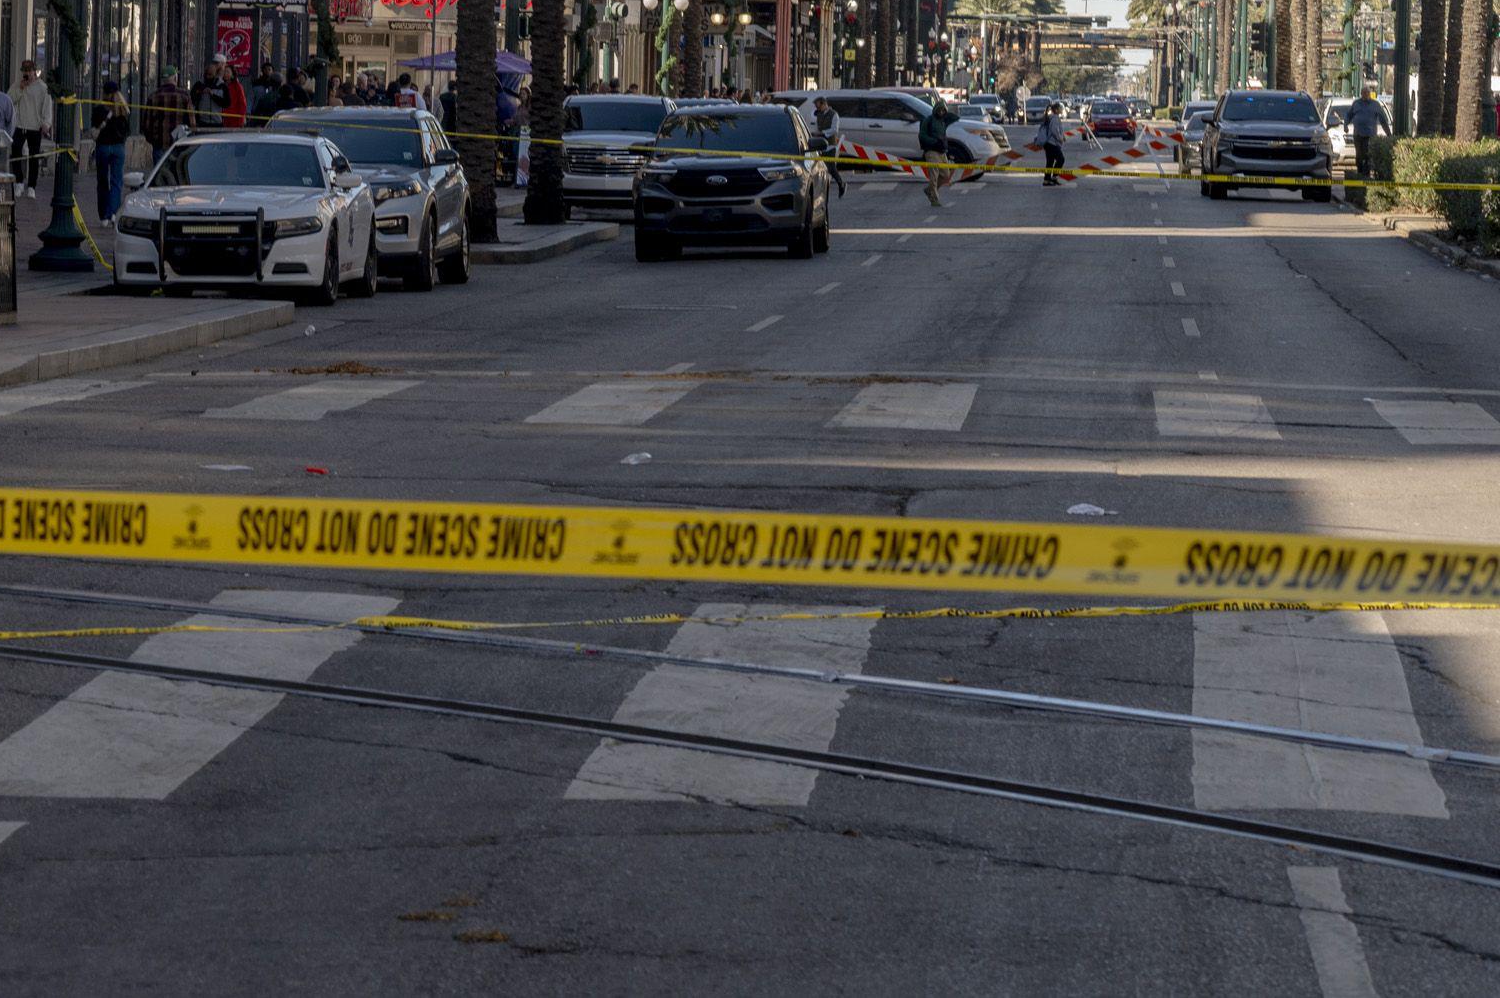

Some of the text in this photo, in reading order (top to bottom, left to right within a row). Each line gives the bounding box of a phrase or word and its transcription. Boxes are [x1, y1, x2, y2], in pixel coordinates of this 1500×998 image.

[12, 499, 76, 543] SCENE
[82, 502, 148, 547] CRIME
[237, 506, 567, 562] CRIME SCENE DO NOT CROSS
[669, 520, 1062, 581] CRIME SCENE DO NOT CROSS
[1176, 541, 1499, 599] CENE DO NOT CROSS
